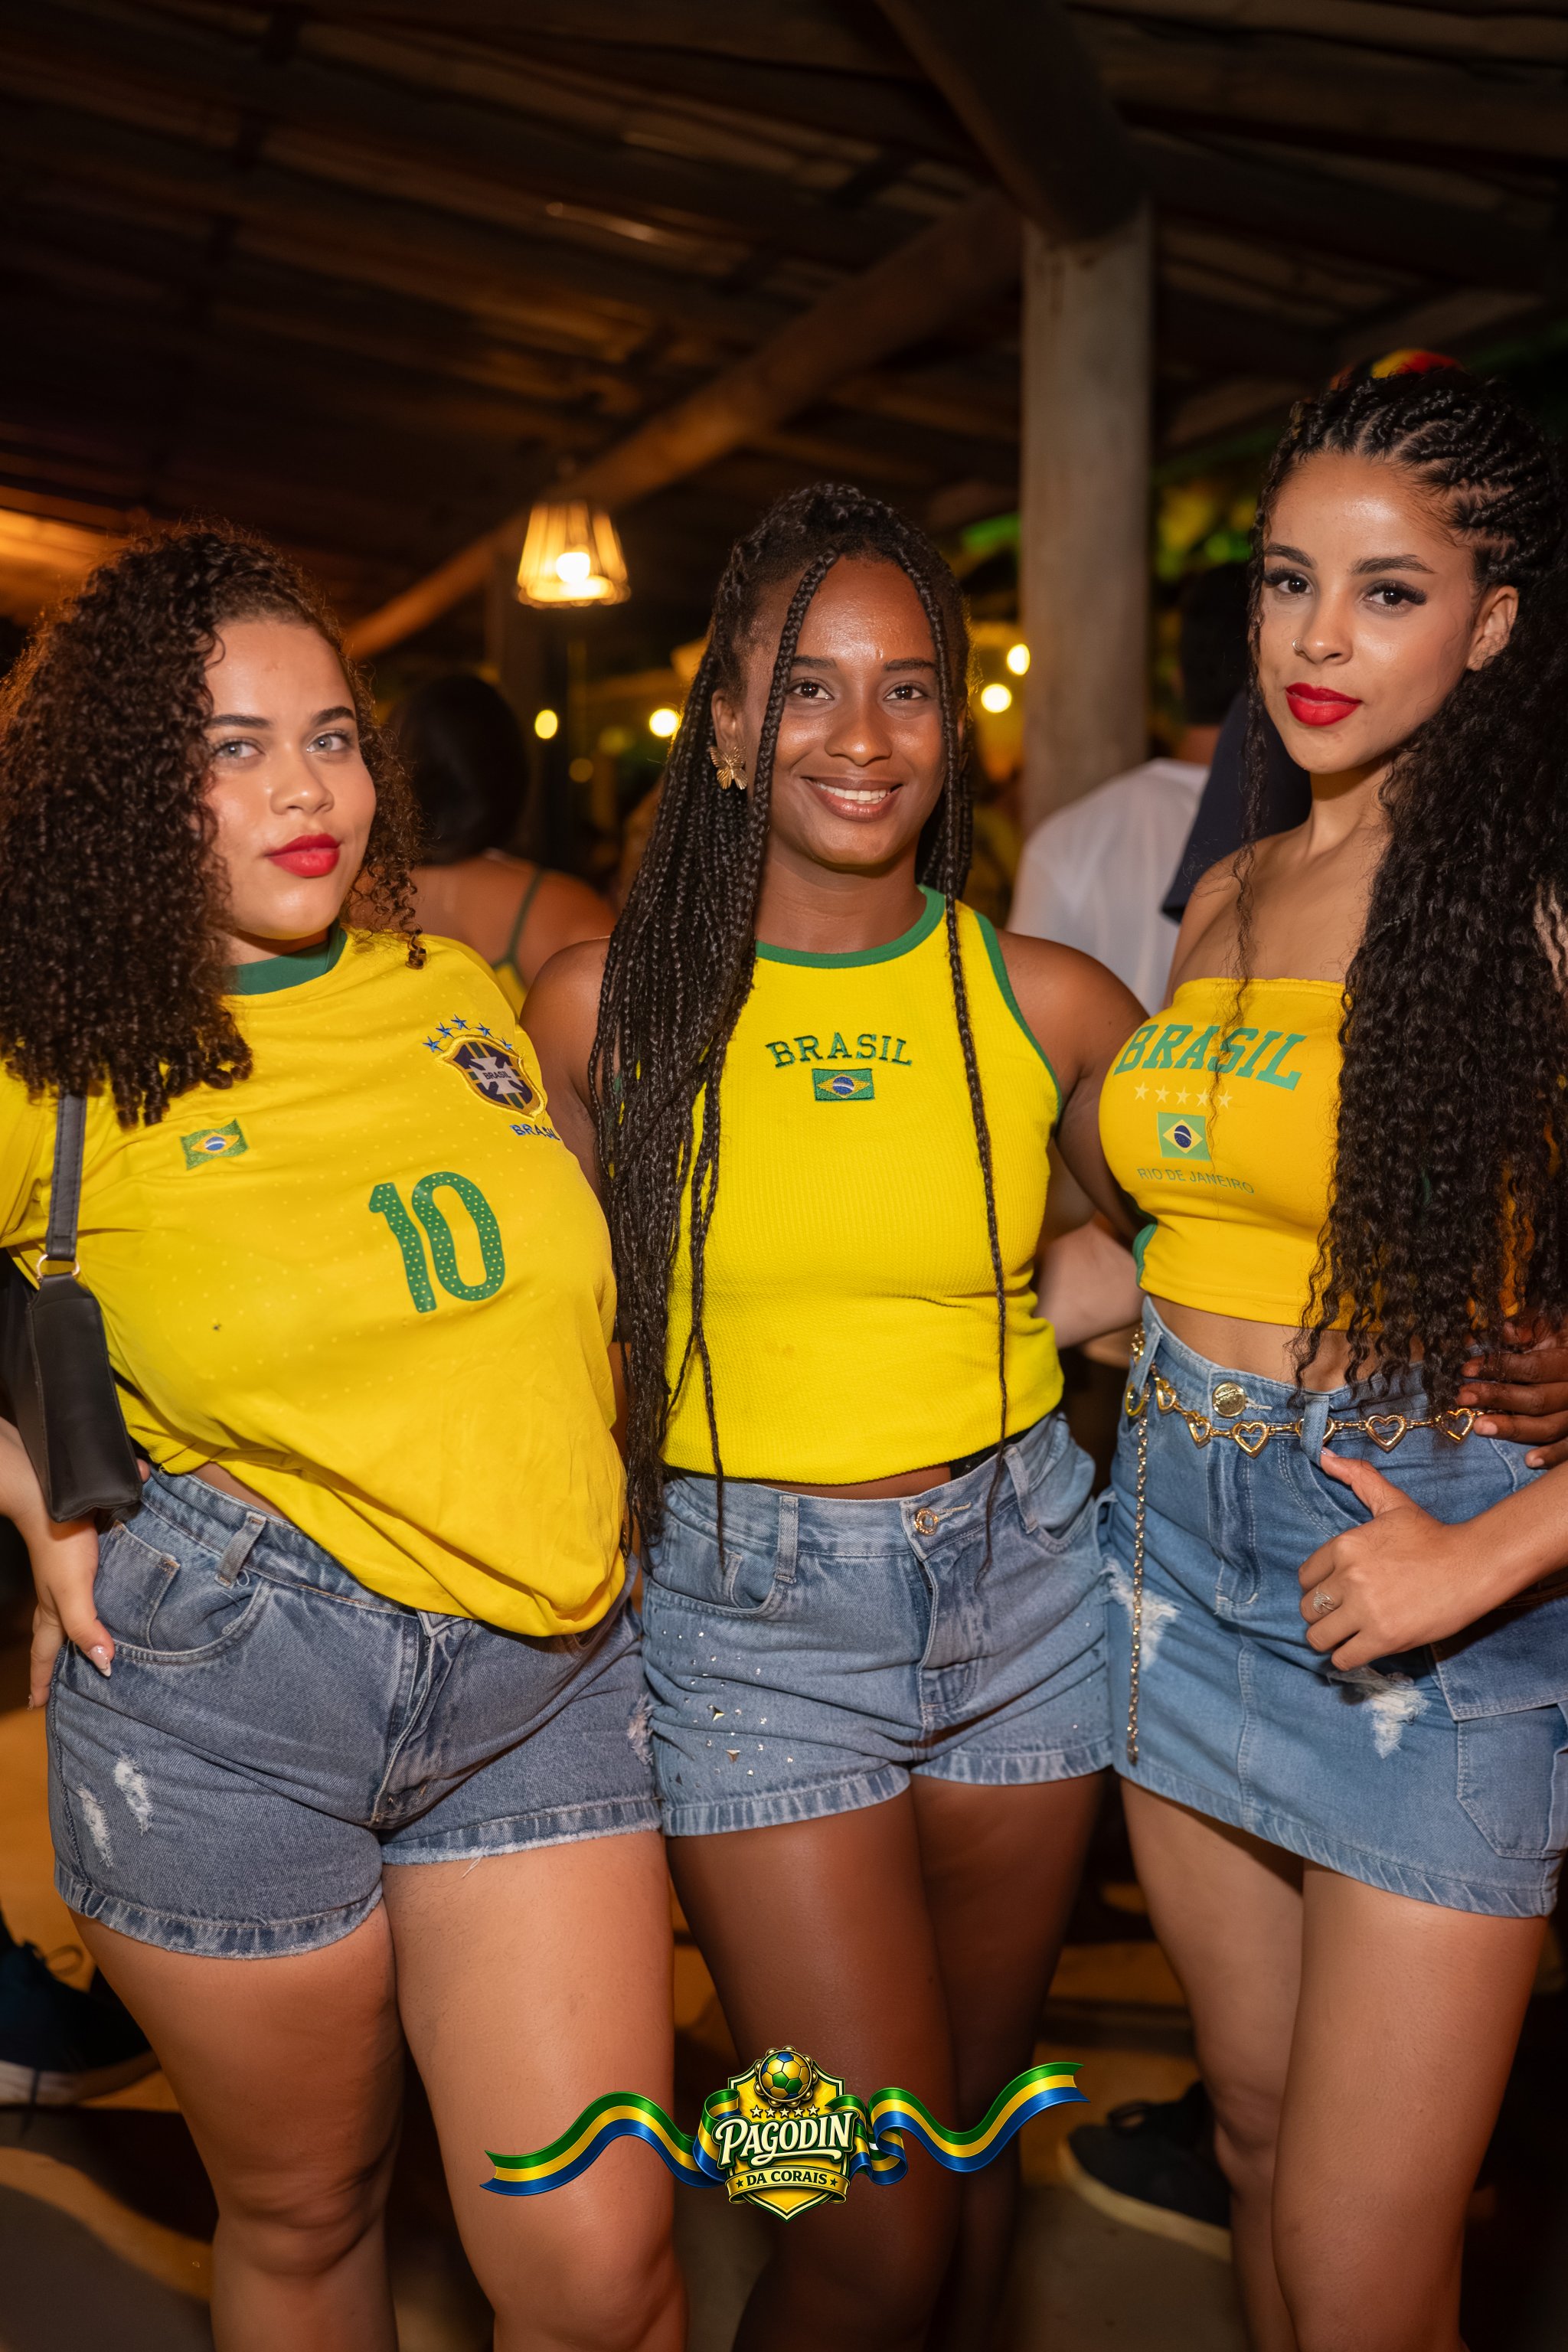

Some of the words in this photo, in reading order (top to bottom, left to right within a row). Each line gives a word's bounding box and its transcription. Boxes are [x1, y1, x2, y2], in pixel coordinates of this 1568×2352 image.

[765, 1031, 912, 1068] BRASIL
[1112, 1024, 1308, 1091] BRASIL
[482, 1071, 511, 1080] BRASIL
[1137, 1168, 1163, 1181] RIO
[1165, 1169, 1186, 1181] DE
[1189, 1171, 1255, 1194] JANEIRO
[369, 1171, 506, 1313] 10
